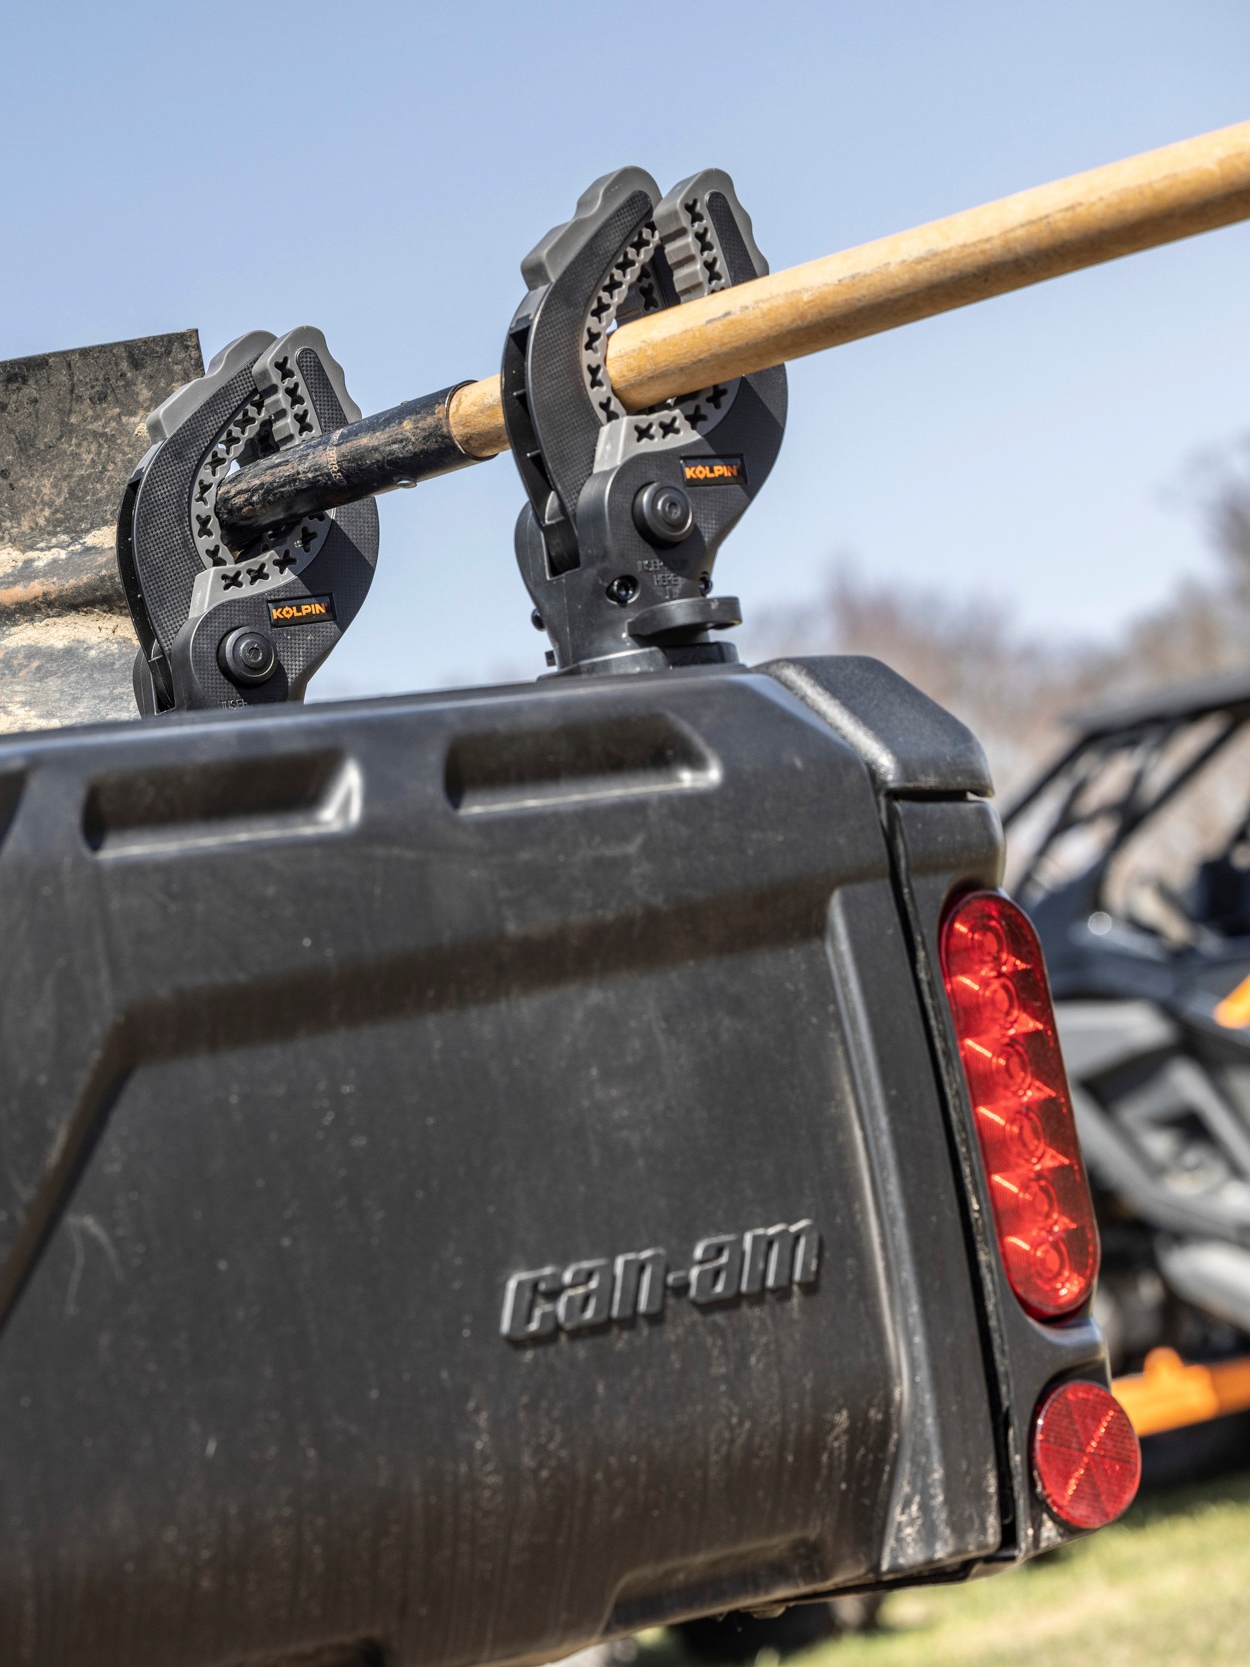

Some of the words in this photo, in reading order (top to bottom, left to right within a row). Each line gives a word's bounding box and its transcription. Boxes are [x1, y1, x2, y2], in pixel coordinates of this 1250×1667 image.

[684, 465, 738, 479] KOLPIN
[272, 603, 326, 619] KOLPIN
[501, 1217, 819, 1338] can-am
